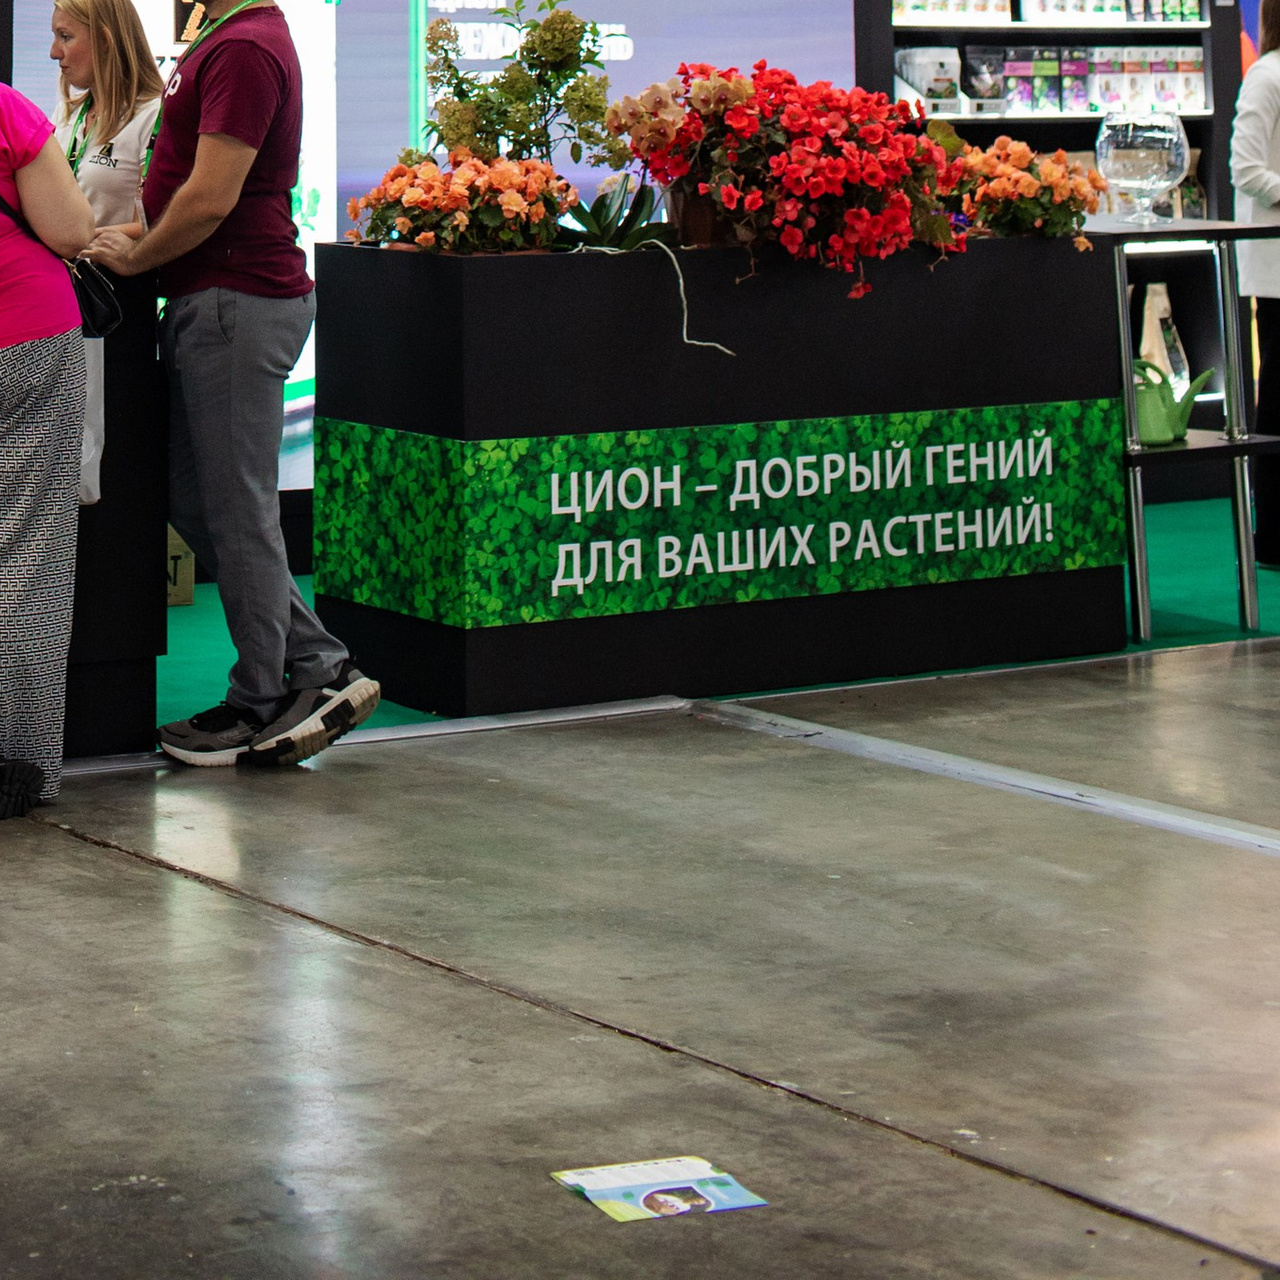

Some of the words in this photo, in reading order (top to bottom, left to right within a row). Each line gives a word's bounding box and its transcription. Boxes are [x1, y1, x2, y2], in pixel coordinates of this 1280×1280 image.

[89, 155, 118, 168] ZION
[551, 464, 683, 524] ЦИОН
[730, 439, 912, 510] ДОБРЫЙ
[925, 429, 1054, 484] ГЕНИЙ
[552, 540, 643, 597] ДЛЯ
[657, 524, 816, 578] ВАШИХ
[829, 496, 1054, 561] РАСТЕНИЙ!
